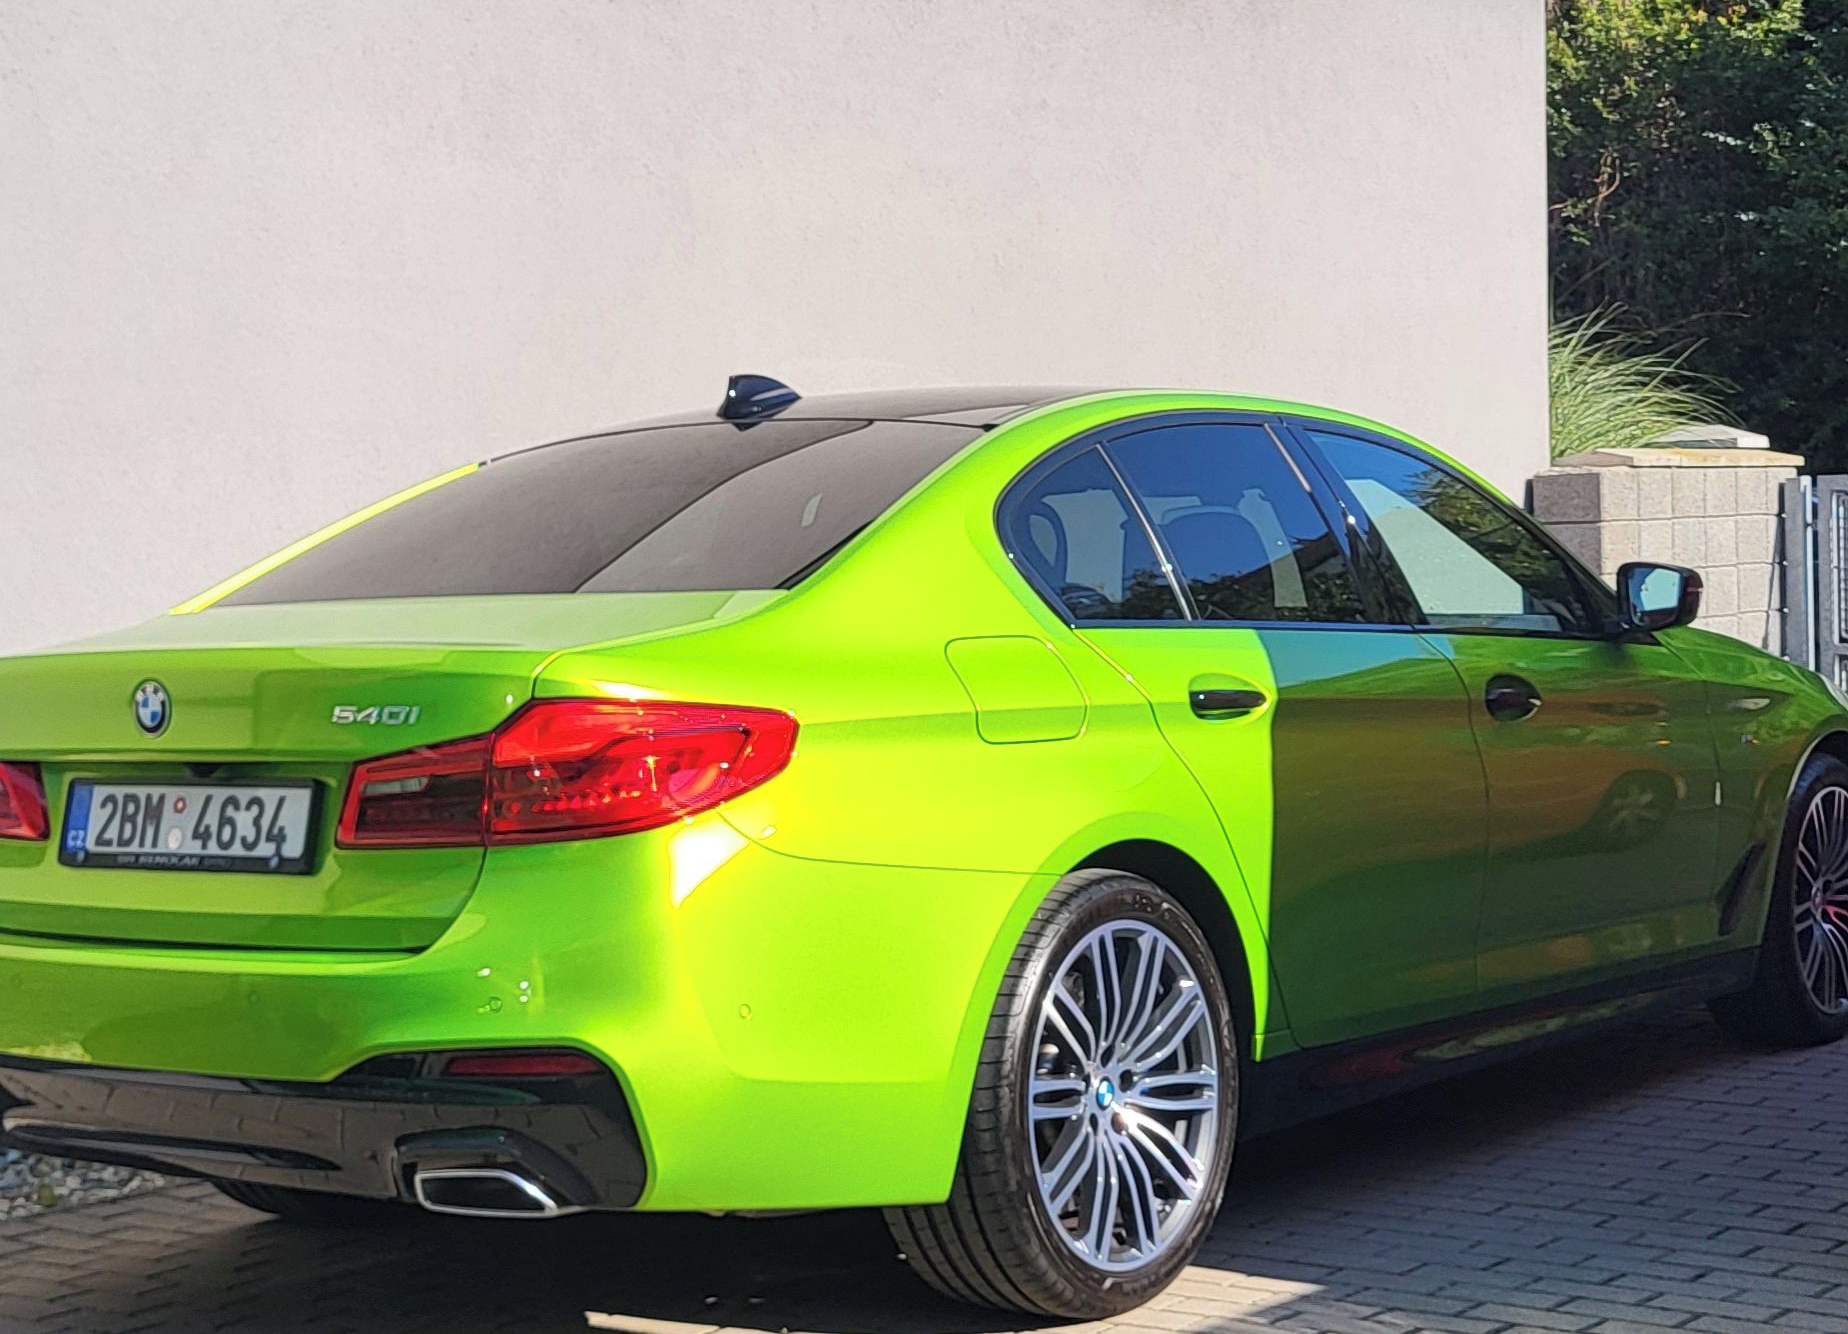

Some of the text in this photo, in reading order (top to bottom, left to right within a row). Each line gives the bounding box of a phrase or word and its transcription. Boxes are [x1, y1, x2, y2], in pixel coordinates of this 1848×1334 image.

[66, 829, 85, 848] CZ
[94, 793, 287, 853] 2BM 4634
